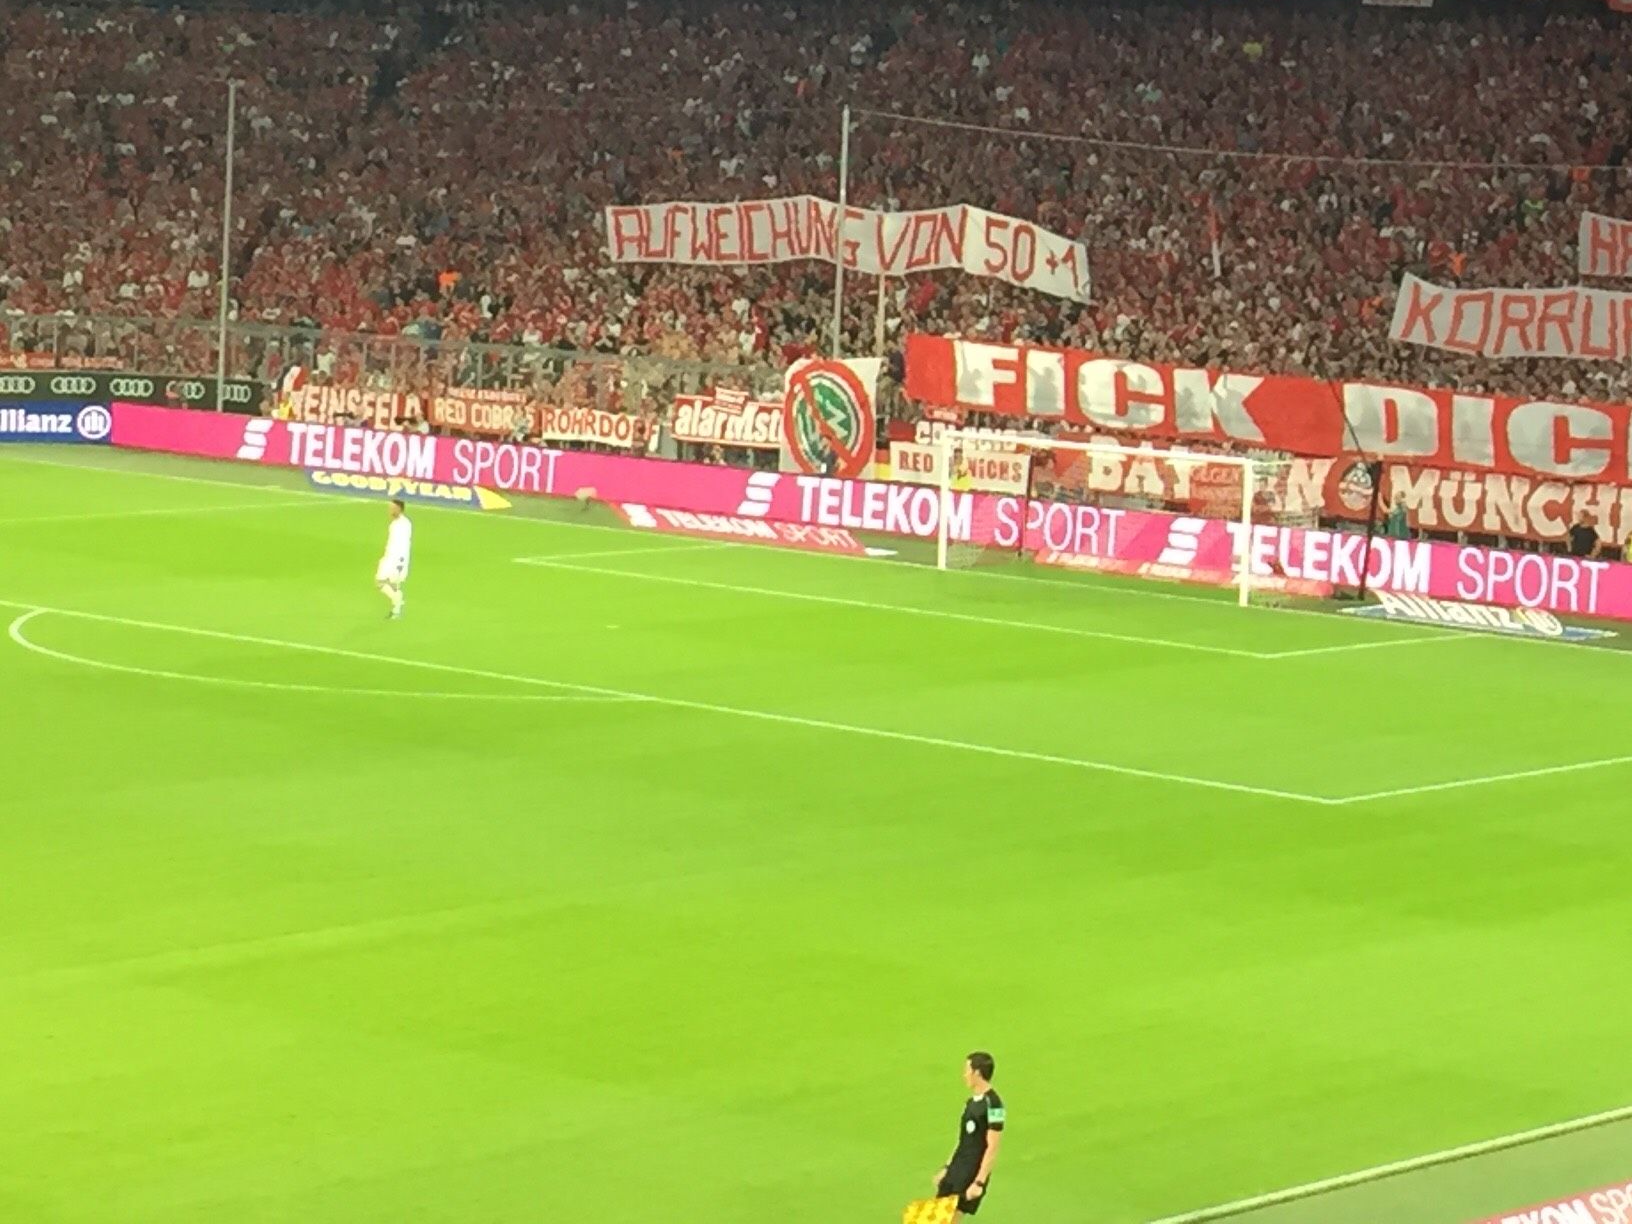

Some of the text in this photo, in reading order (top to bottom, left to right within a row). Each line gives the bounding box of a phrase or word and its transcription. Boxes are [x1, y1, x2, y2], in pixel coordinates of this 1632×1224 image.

[876, 204, 969, 271] VON
[0, 408, 72, 433] llianz
[953, 339, 1266, 443] FICK
[287, 424, 565, 494] TELEKOM SPORT
[311, 470, 473, 502] GOODYEAR
[899, 450, 934, 473] RED
[1087, 435, 1339, 517] BAYN
[797, 476, 974, 542] TELEKOM
[994, 497, 1127, 557] SPORT
[1226, 522, 1432, 594] TELEKOM
[1456, 547, 1611, 614] SPORT
[1372, 588, 1524, 630] Allianz
